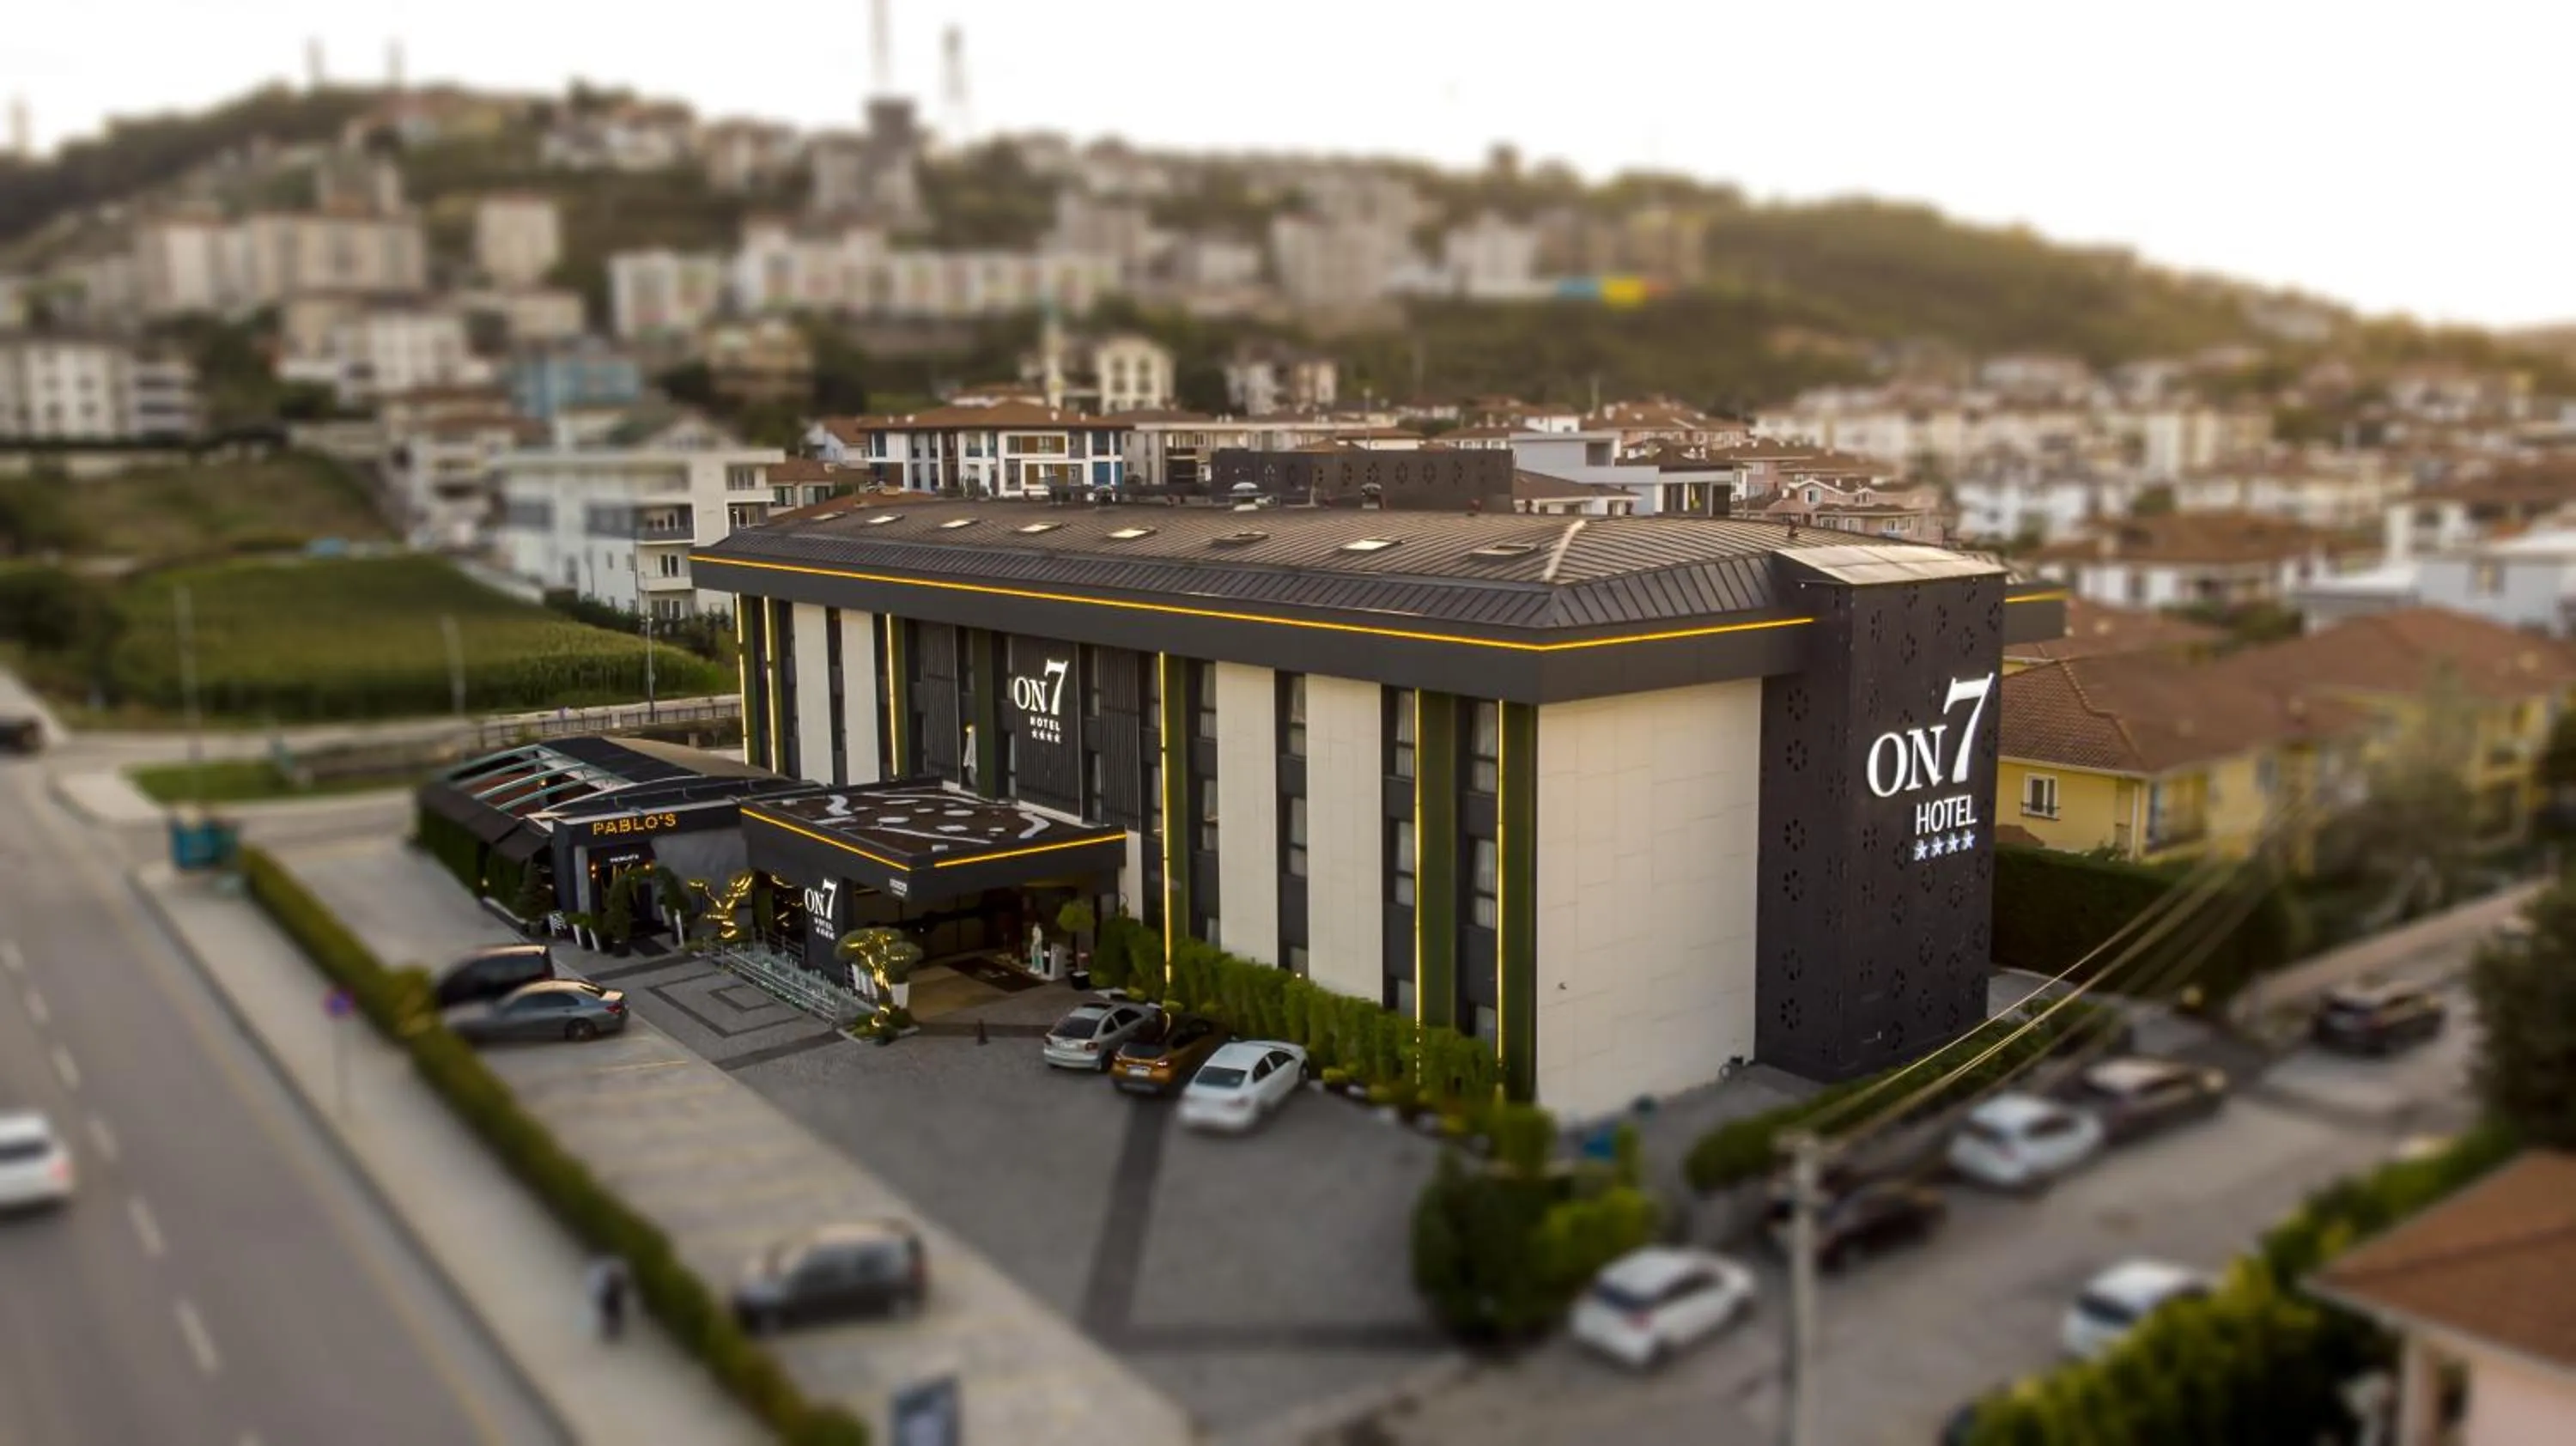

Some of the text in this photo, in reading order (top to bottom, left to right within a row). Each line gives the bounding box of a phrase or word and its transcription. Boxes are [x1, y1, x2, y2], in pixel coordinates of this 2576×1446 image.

[1014, 659, 1069, 715] ON7
[1030, 716, 1061, 732] HOTEL
[1867, 672, 1995, 798] ON7
[592, 812, 677, 835] PABLO'S
[1915, 794, 1978, 835] HOTEL
